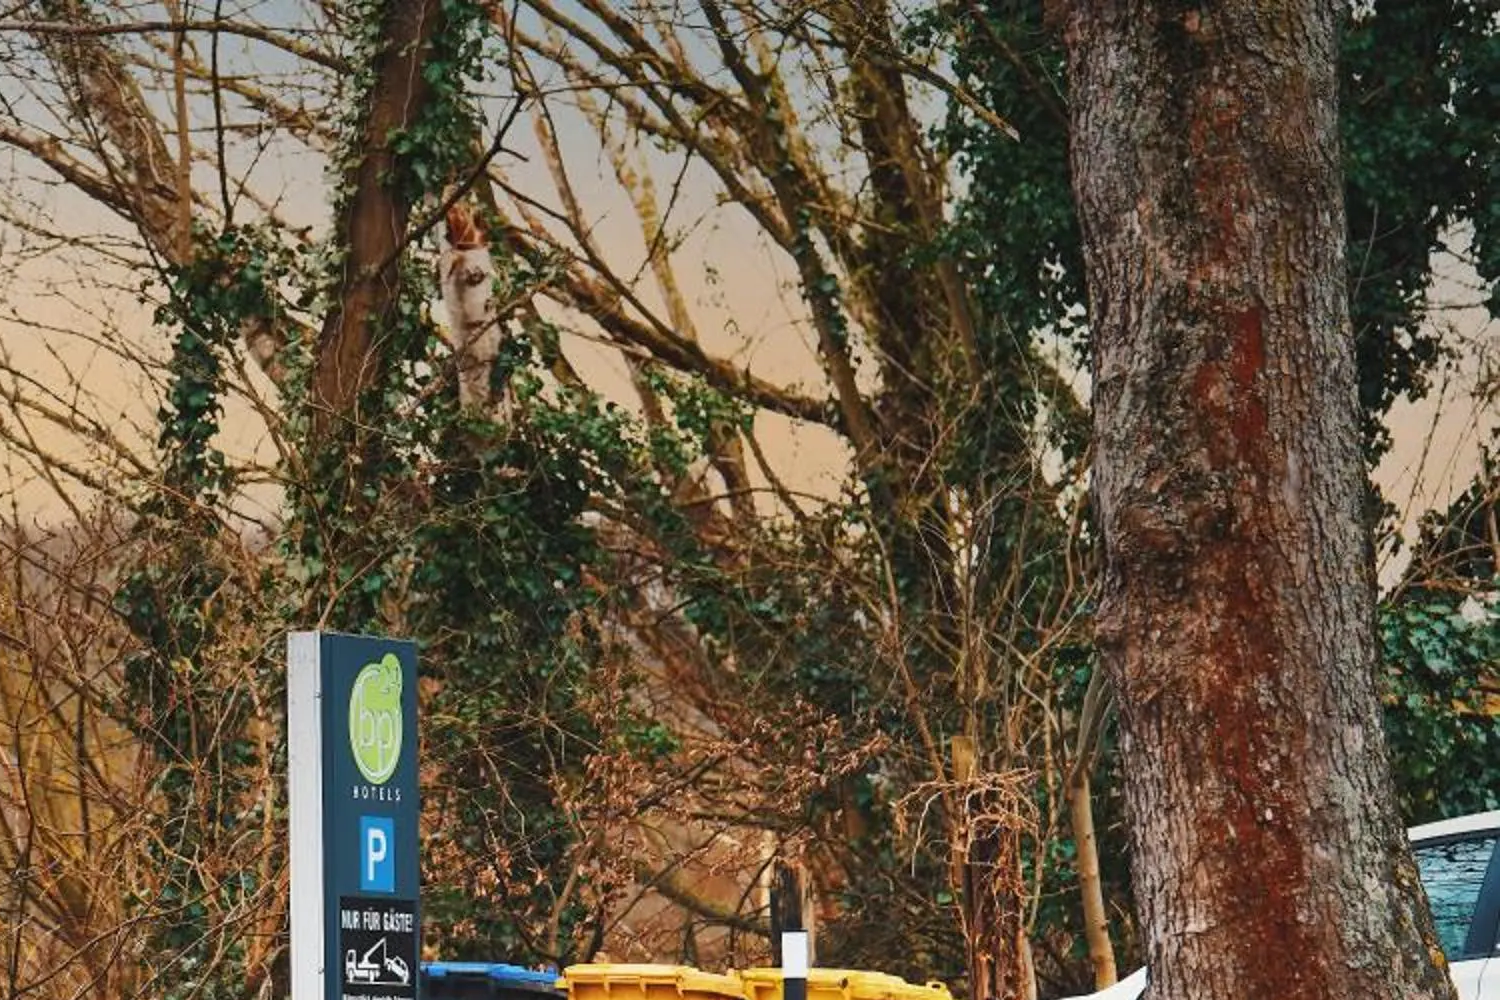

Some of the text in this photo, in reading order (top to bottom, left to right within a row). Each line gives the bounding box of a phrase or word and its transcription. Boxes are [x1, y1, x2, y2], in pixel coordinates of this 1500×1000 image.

[353, 785, 401, 801] HOTELS
[368, 828, 387, 881] P
[341, 909, 360, 929] NUR
[363, 907, 381, 931] FÜR
